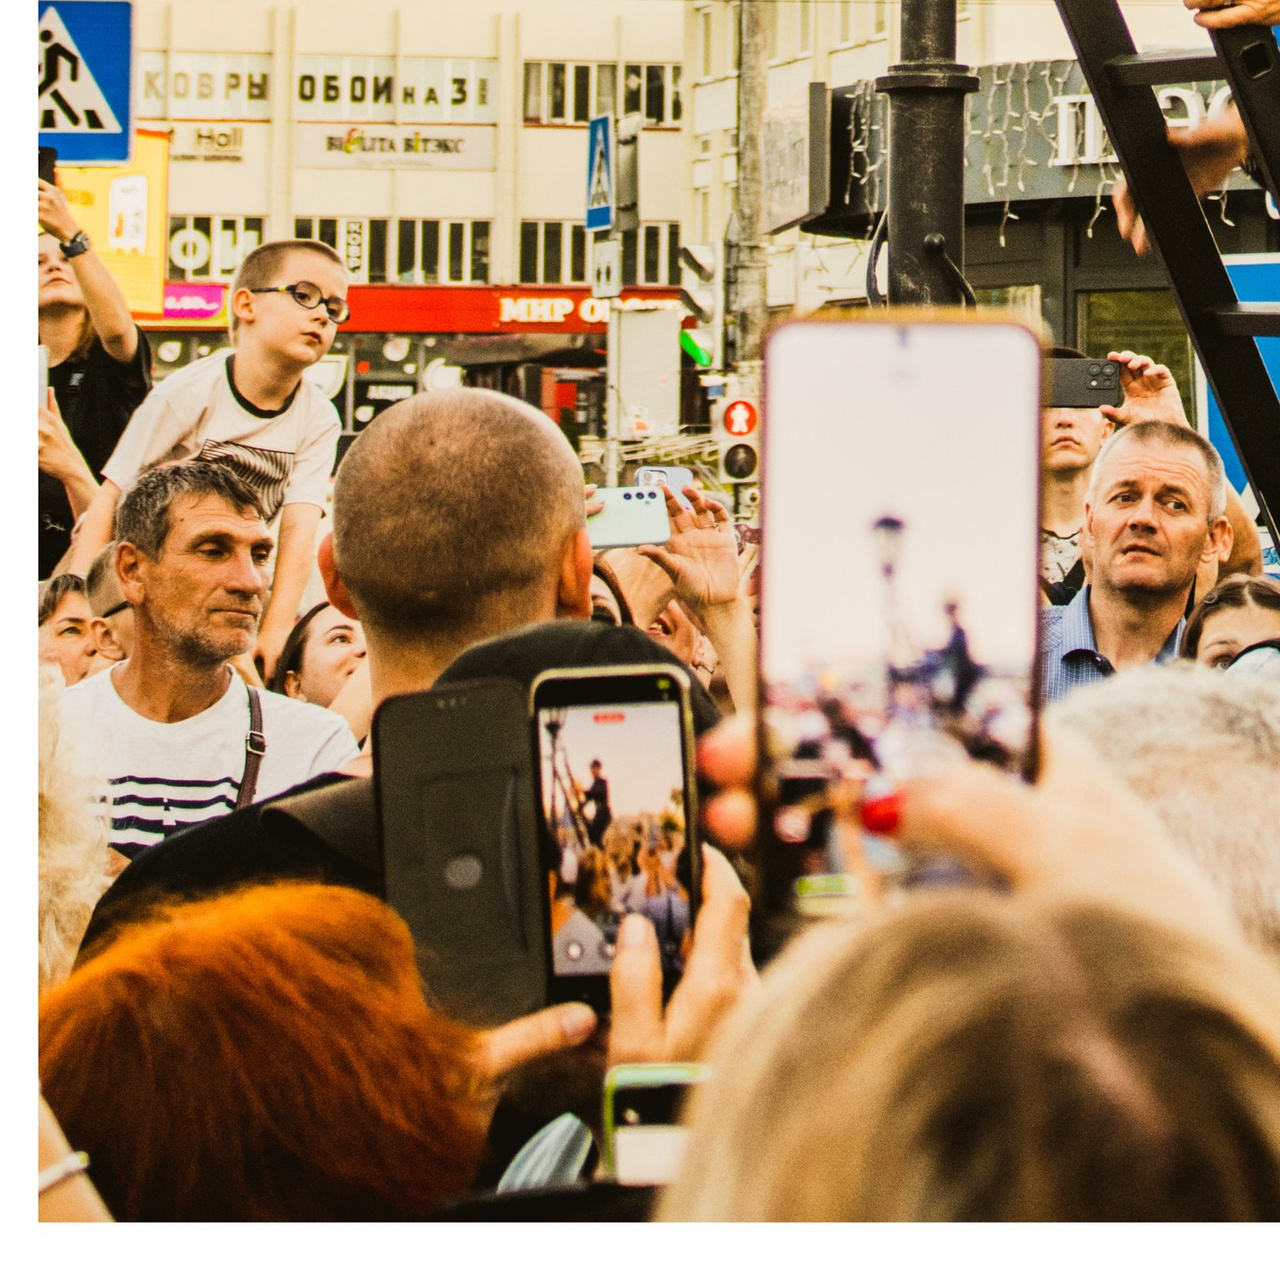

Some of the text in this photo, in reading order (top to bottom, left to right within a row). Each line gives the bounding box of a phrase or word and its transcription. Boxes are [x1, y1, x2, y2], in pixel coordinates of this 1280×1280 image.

[143, 71, 269, 101] КОВРЫ
[298, 74, 394, 104] ОБОИ
[451, 78, 468, 106] 3
[196, 128, 243, 148] Hall
[499, 297, 575, 323] МИР
